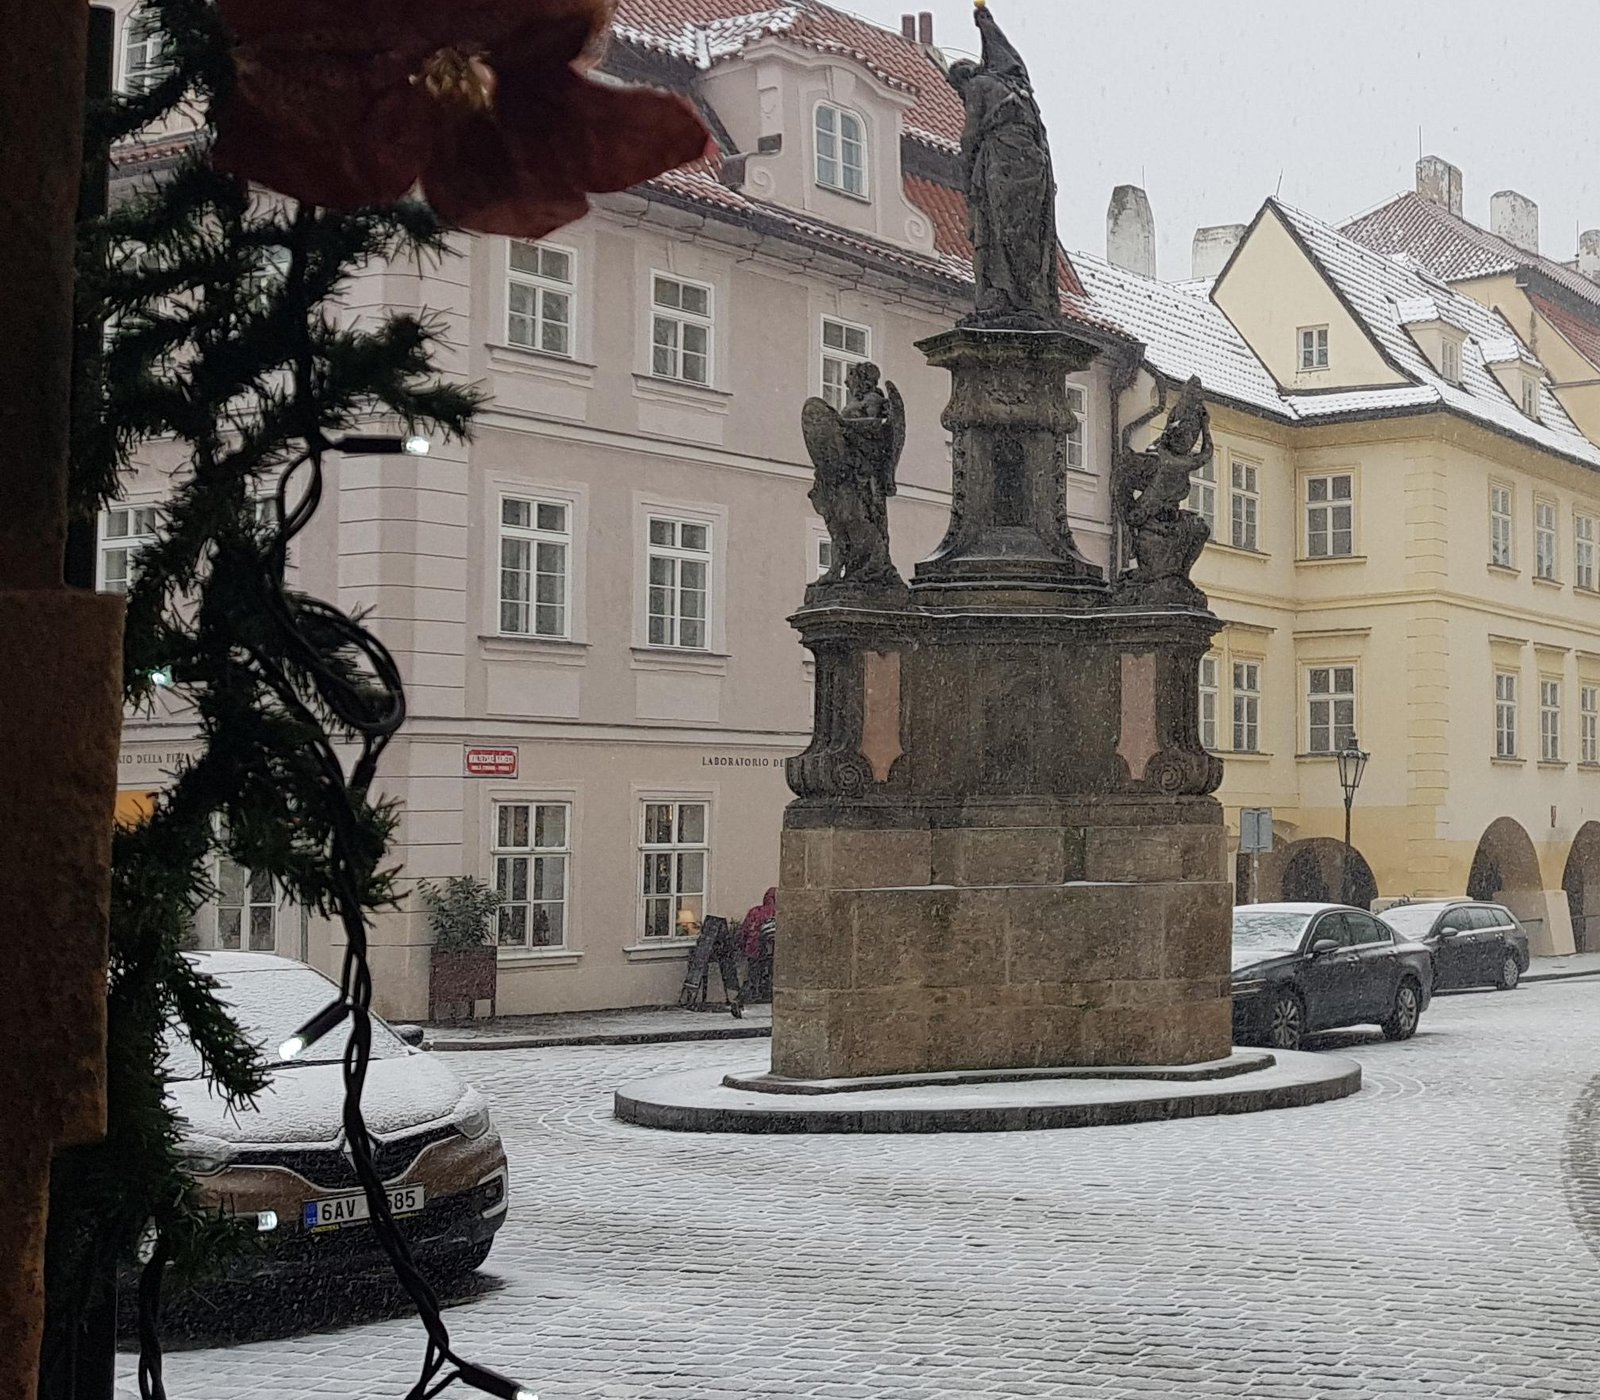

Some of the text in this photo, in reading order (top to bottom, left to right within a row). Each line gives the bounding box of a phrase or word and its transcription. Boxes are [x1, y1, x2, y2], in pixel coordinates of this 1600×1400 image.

[137, 753, 162, 764] DELLA
[702, 756, 769, 767] LABORATORIO
[322, 1199, 356, 1221] 6AV
